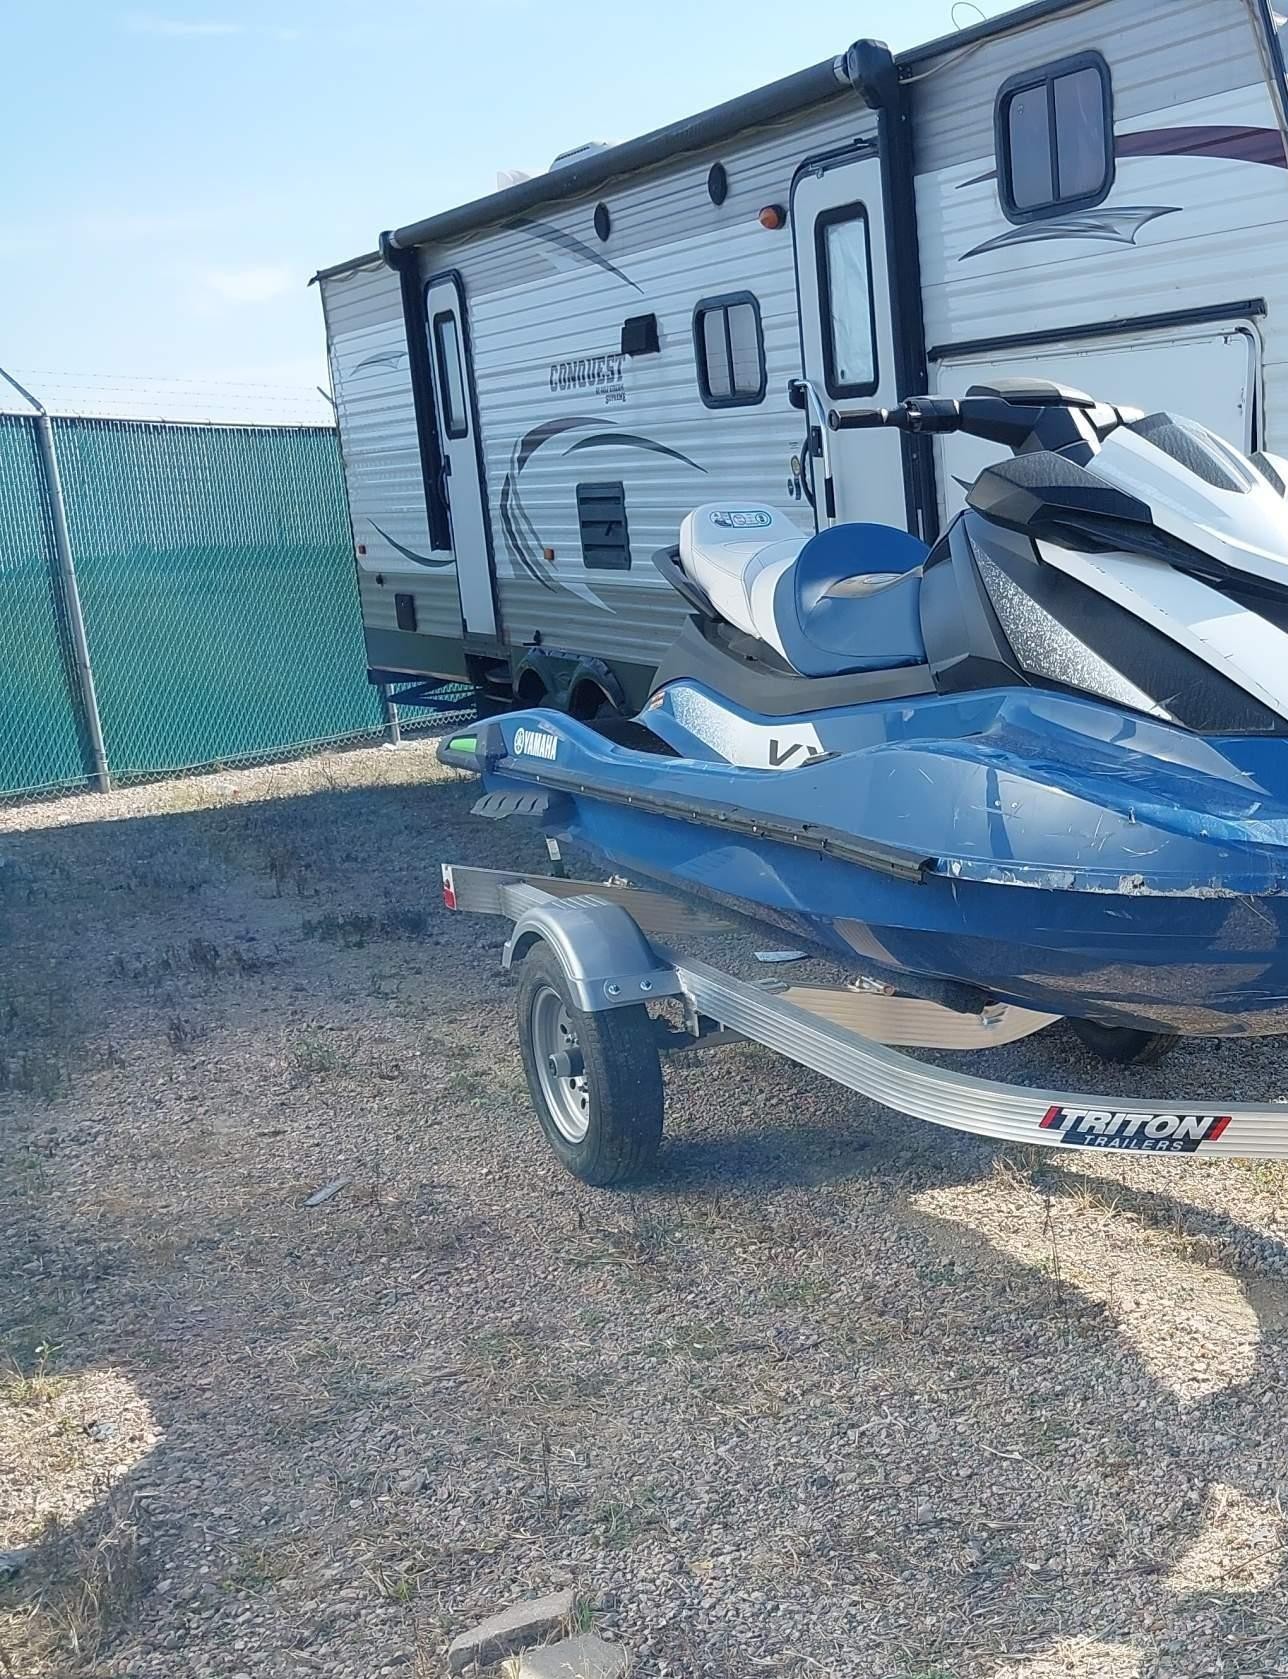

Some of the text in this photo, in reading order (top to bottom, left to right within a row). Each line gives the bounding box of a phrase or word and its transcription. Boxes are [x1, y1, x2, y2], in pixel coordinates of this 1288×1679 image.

[550, 355, 626, 392] CONQUEST
[524, 730, 558, 761] YAMAHA
[1059, 1108, 1214, 1140] TRITON
[1084, 1134, 1184, 1151] TRAILERS
